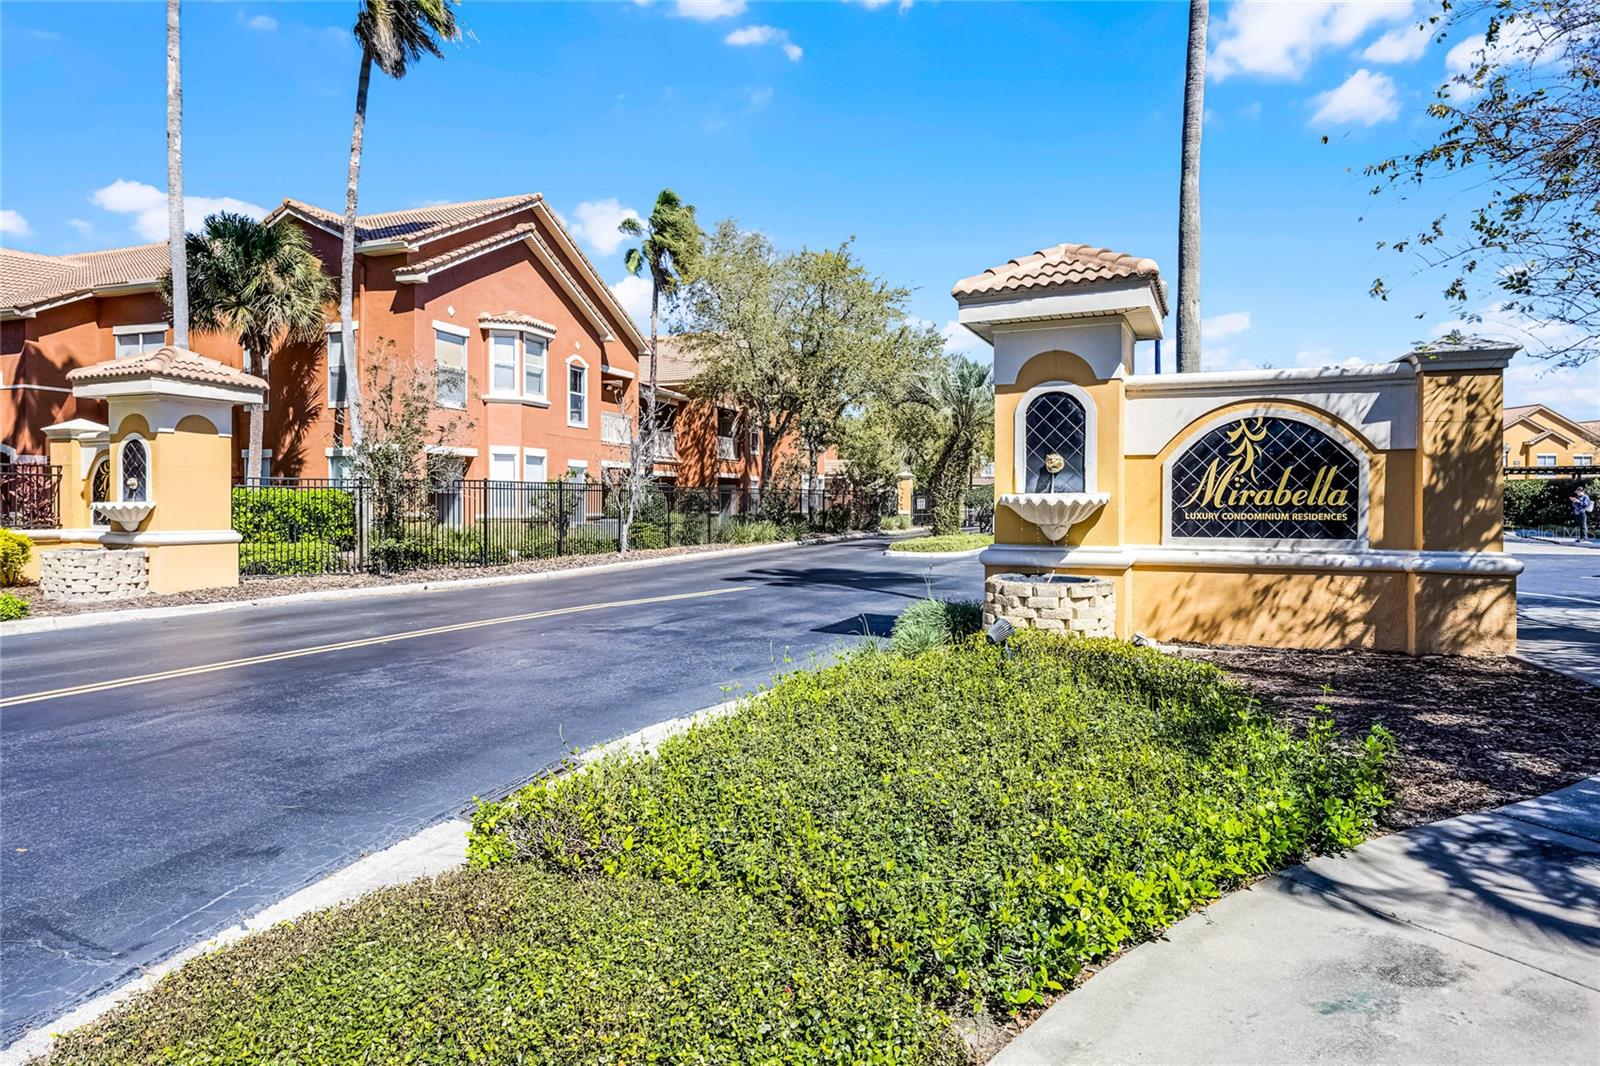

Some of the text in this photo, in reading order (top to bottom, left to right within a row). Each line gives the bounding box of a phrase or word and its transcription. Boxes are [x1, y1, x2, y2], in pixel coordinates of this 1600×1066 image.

[1181, 457, 1348, 508] Mirabella
[1185, 512, 1348, 521] LUXURY CONDOMINIUM RESIDENCES
